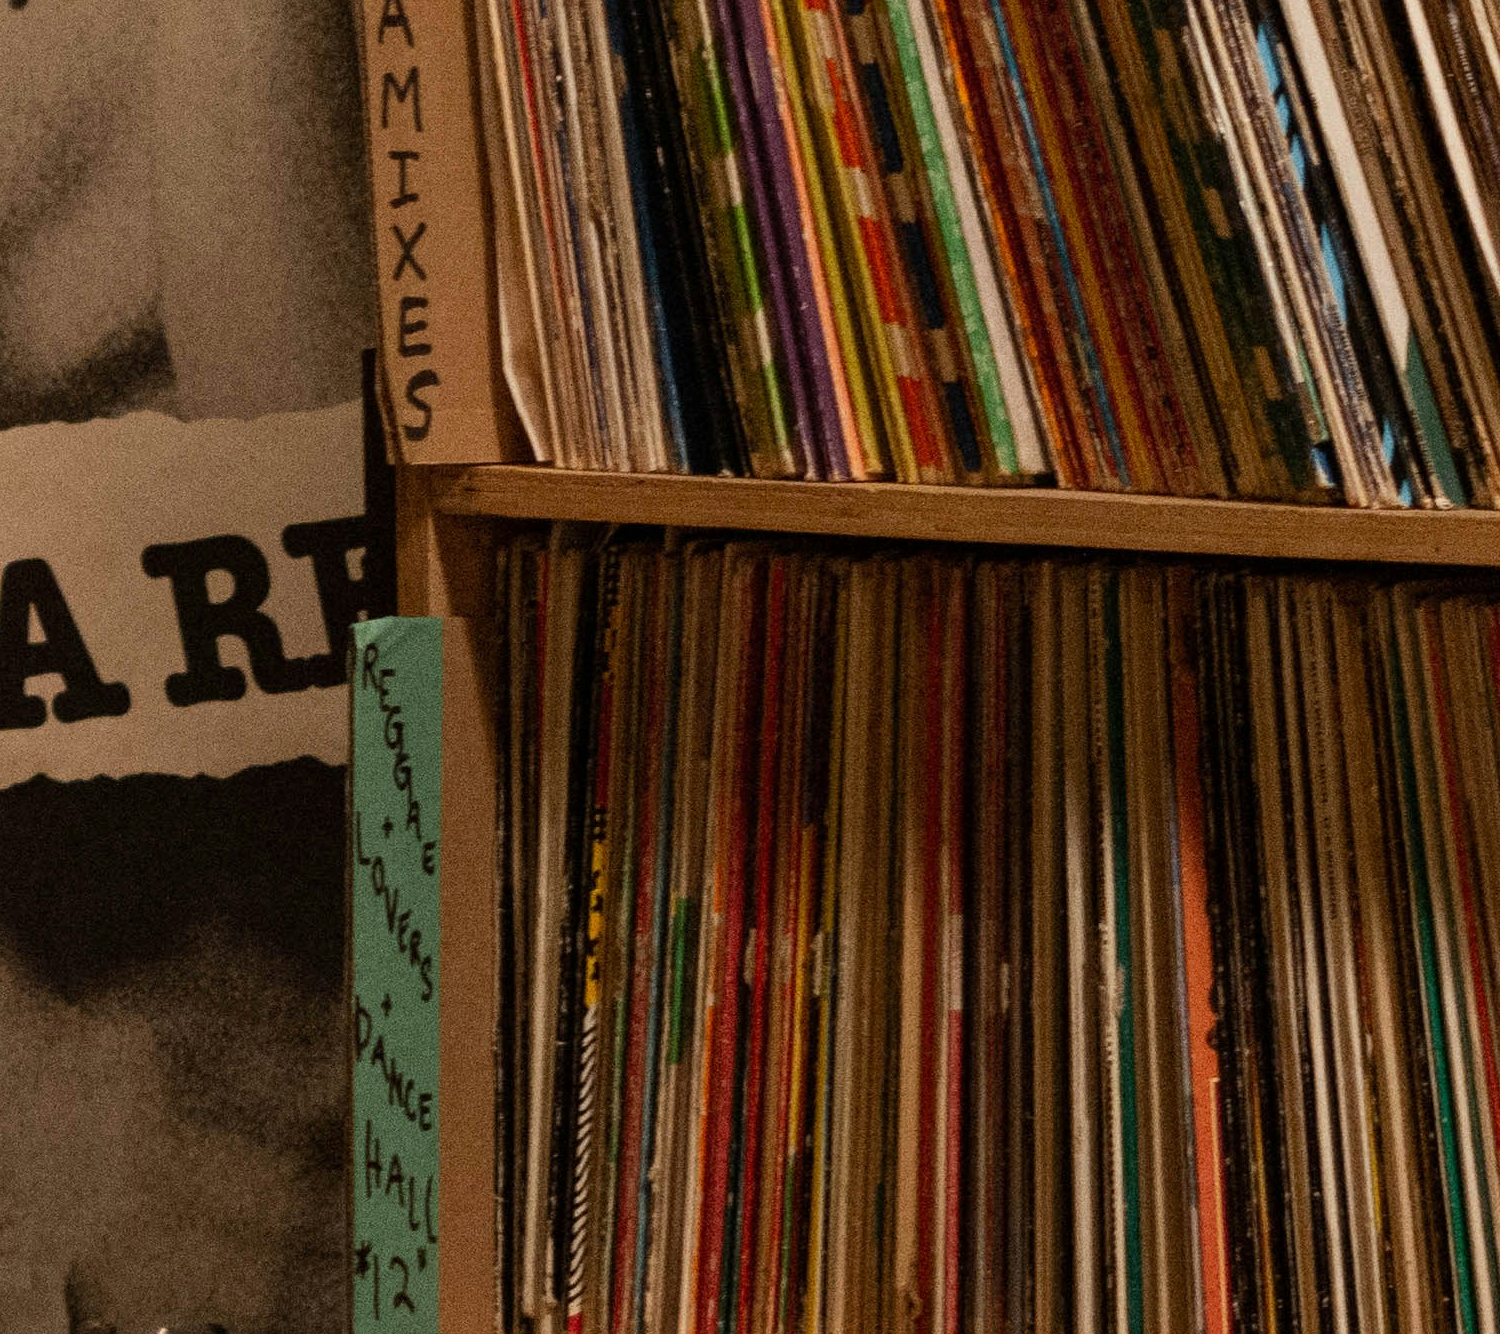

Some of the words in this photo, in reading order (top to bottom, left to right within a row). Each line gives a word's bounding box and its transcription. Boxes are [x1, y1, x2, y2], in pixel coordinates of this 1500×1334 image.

[361, 642, 437, 877] REGGAE
[355, 810, 436, 1004] LOVERS
[355, 994, 436, 1134] DANCE
[363, 1119, 440, 1246] HALL
